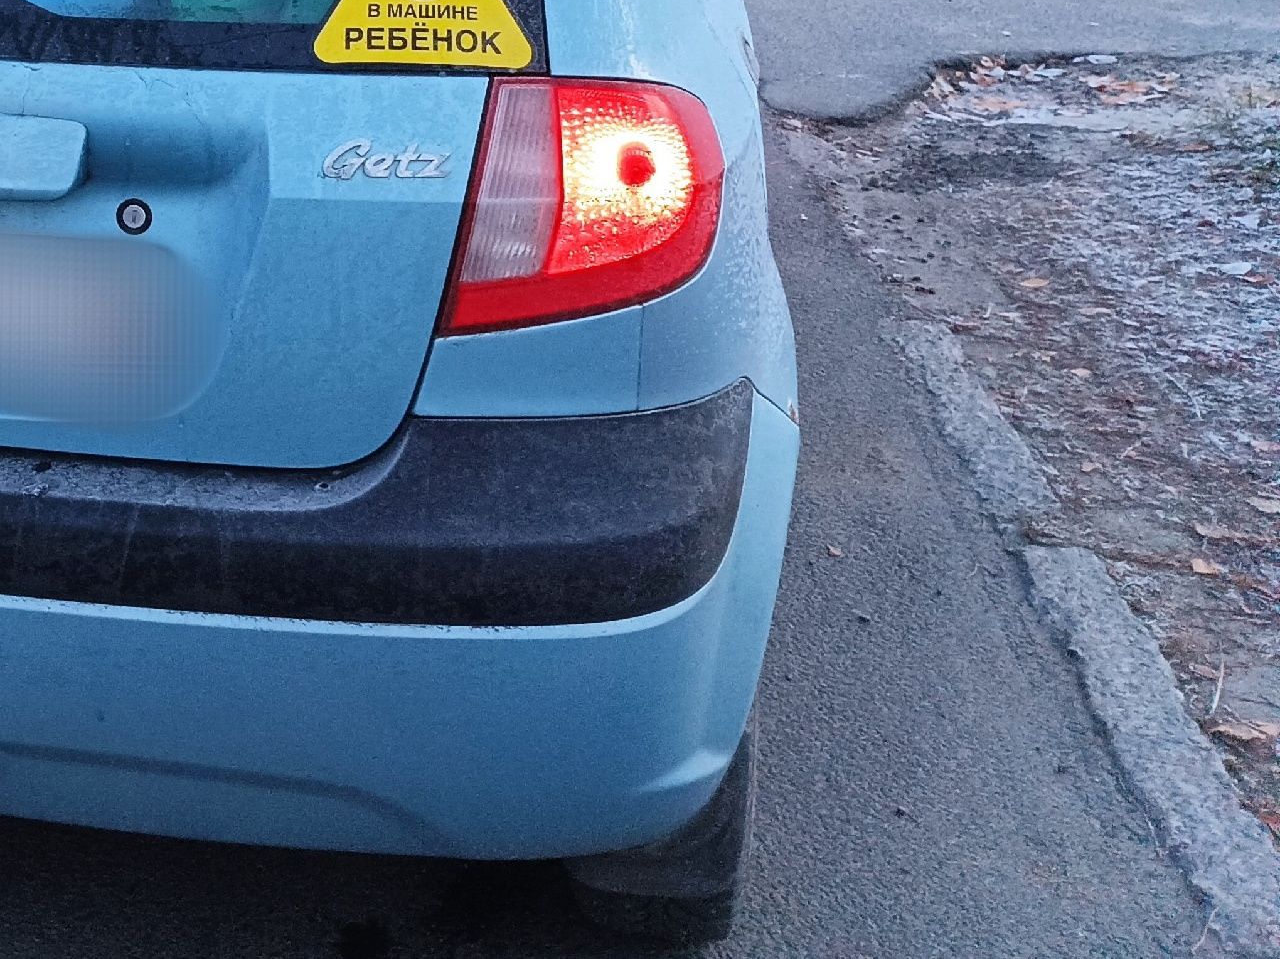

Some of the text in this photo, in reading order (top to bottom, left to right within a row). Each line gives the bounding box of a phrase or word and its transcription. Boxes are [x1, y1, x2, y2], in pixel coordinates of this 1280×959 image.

[367, 3, 478, 21] В МАШИНЕ
[344, 22, 502, 55] РЕБЁНОК
[322, 138, 450, 180] Getz
